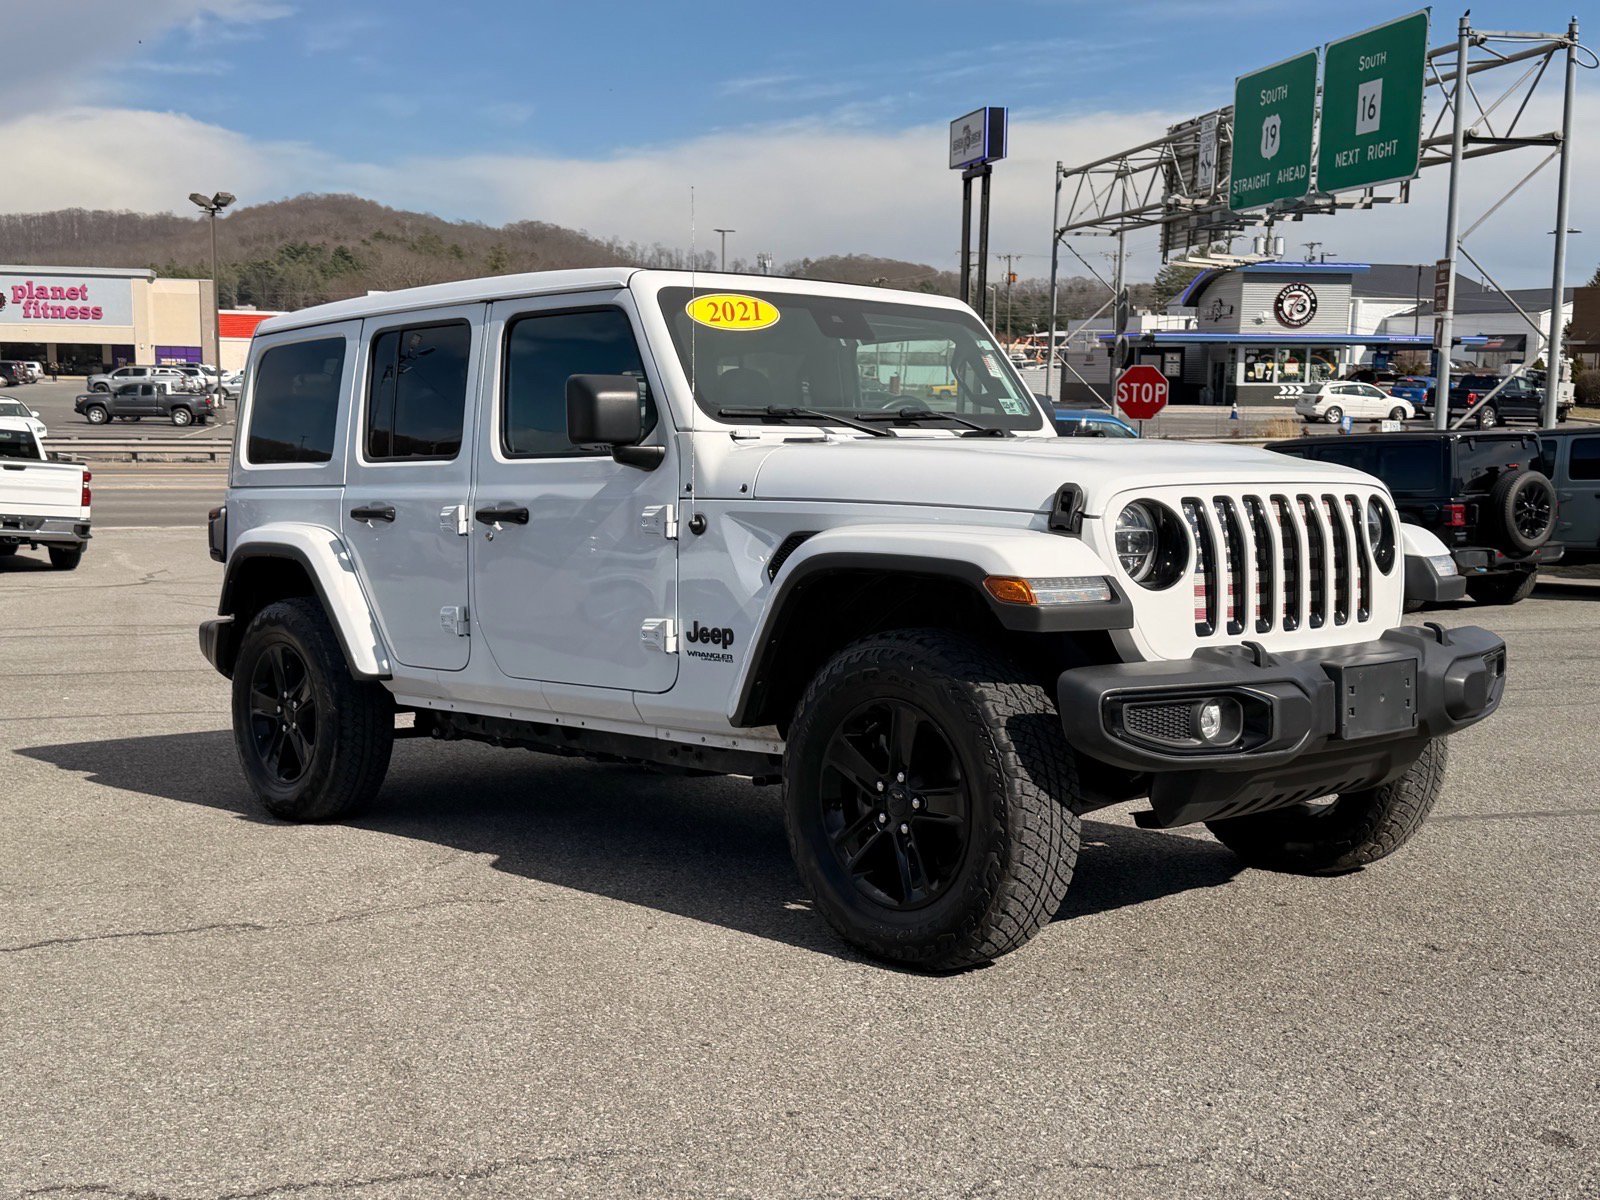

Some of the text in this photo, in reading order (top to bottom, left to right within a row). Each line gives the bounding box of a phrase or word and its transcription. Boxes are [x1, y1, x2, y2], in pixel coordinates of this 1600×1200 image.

[1359, 51, 1387, 72] SOUTH
[1260, 84, 1288, 107] SOUTH
[1361, 94, 1377, 122] 16
[1265, 124, 1277, 150] 19
[1335, 139, 1399, 168] NEXT RIGHT
[1233, 164, 1306, 194] STRAIGHT AHEAD
[11, 281, 88, 304] planet
[23, 299, 103, 320] fitness
[706, 301, 763, 322] 2021
[1117, 382, 1167, 403] STOP
[686, 620, 735, 650] Jeep
[687, 650, 734, 660] WRANGLER
